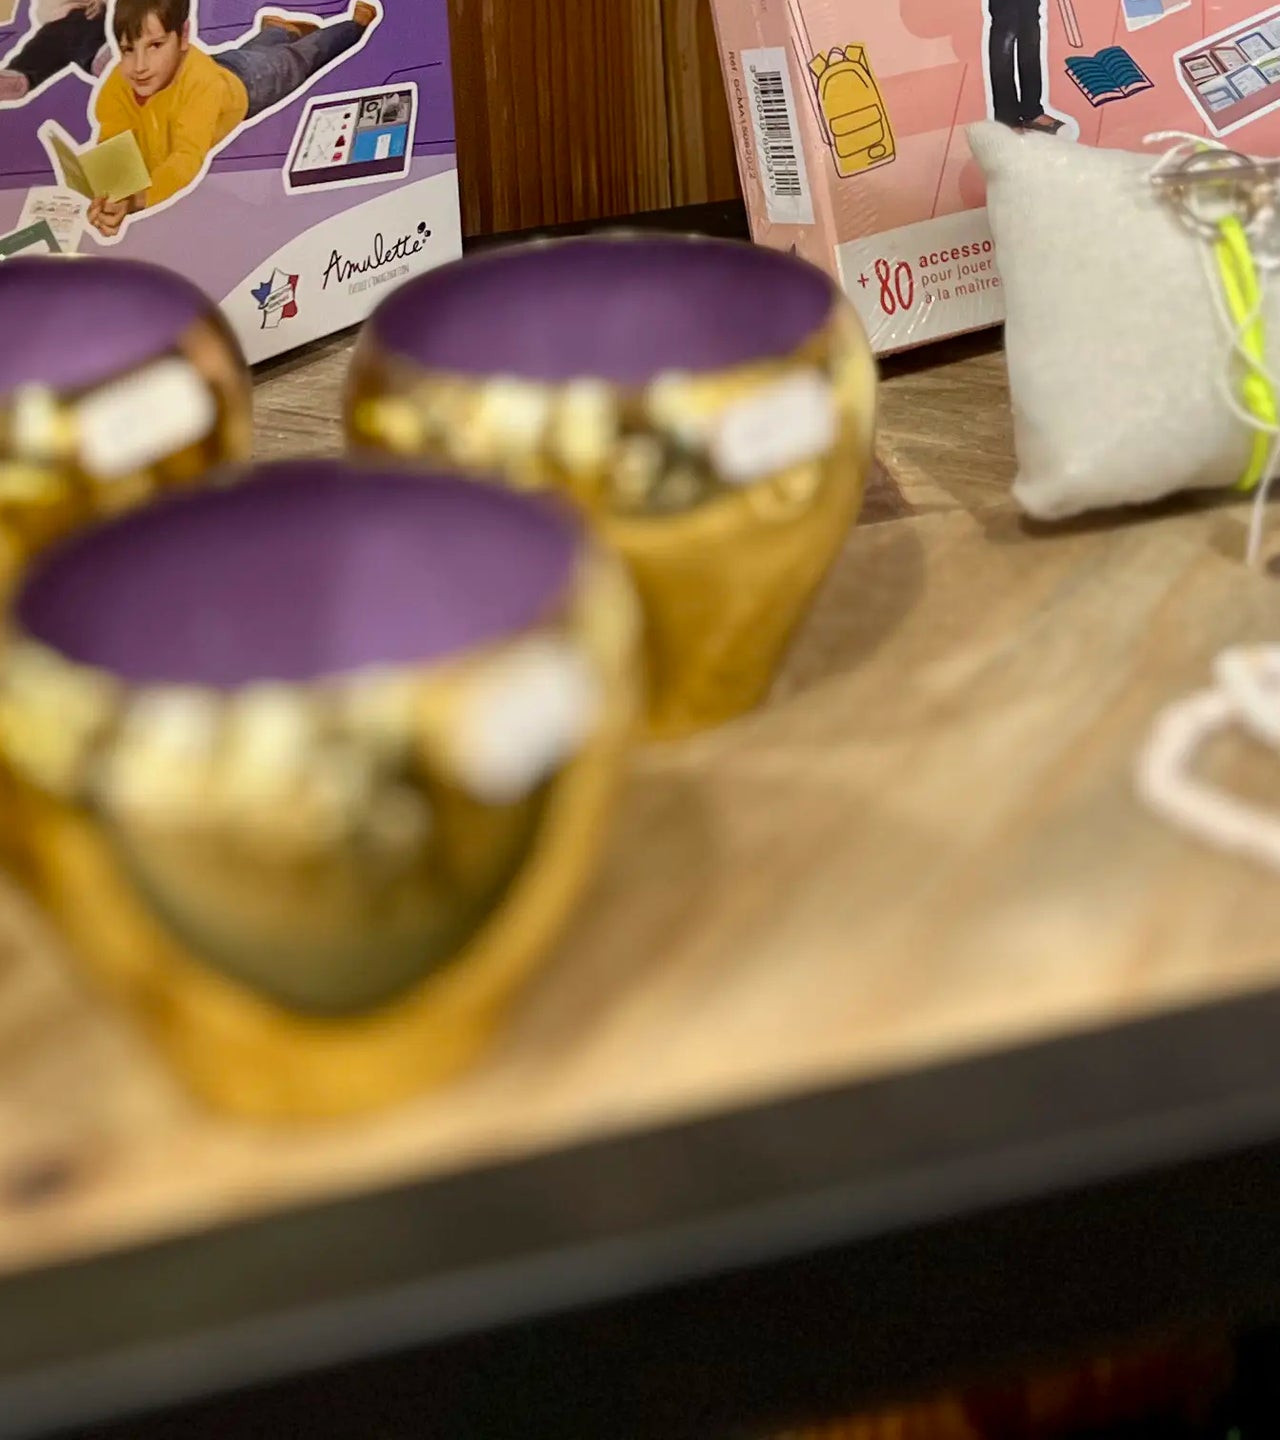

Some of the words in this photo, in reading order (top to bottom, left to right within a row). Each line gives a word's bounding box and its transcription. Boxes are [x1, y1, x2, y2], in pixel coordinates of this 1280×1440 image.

[321, 232, 423, 291] Amulette
[918, 240, 996, 269] accesso
[921, 268, 953, 288] pour
[957, 259, 992, 280] jouer
[924, 291, 933, 304] à
[938, 287, 951, 301] la
[954, 274, 1002, 298] maître
